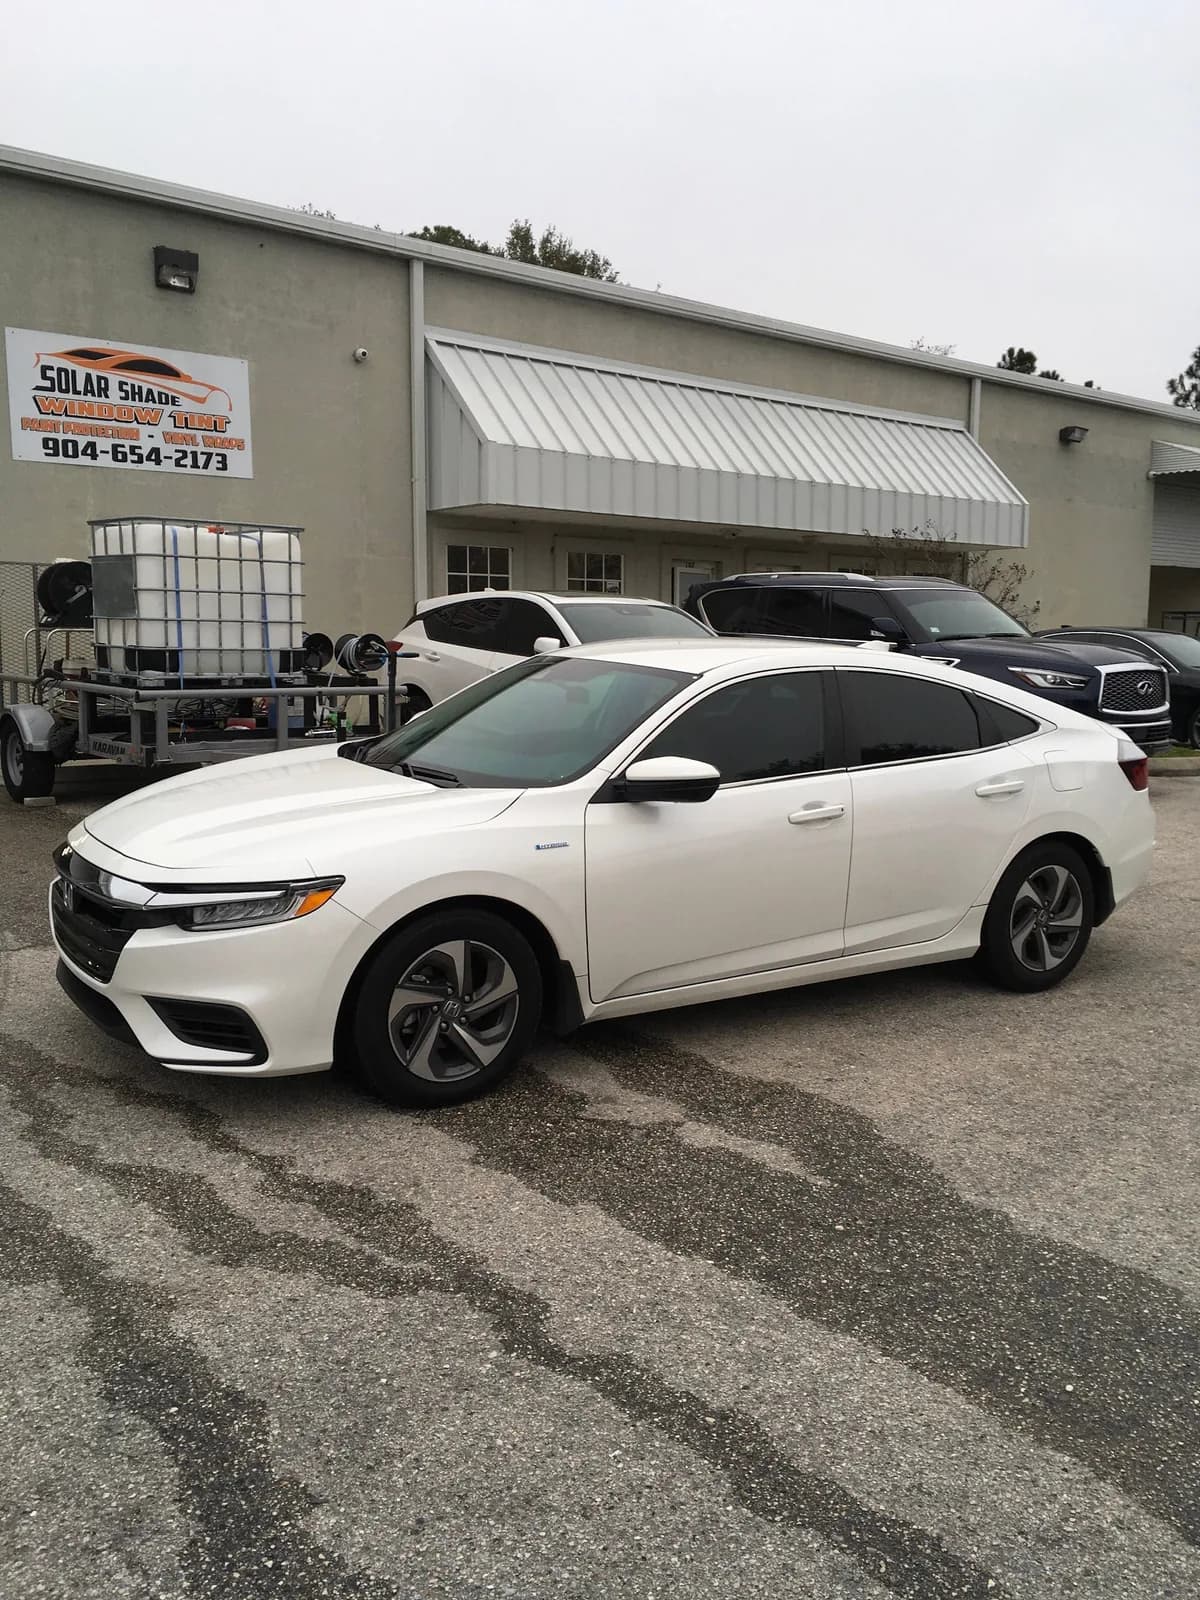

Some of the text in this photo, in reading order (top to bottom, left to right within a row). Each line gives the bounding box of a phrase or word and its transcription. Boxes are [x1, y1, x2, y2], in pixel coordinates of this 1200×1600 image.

[32, 365, 182, 406] SOLAR SHADE
[33, 395, 231, 432] WINDOW TINT
[21, 417, 62, 433] PAINT
[63, 422, 140, 440] PROTECTION
[162, 431, 199, 446] VINYL
[202, 435, 245, 450] WRAPS
[42, 437, 228, 471] 904-654-2173
